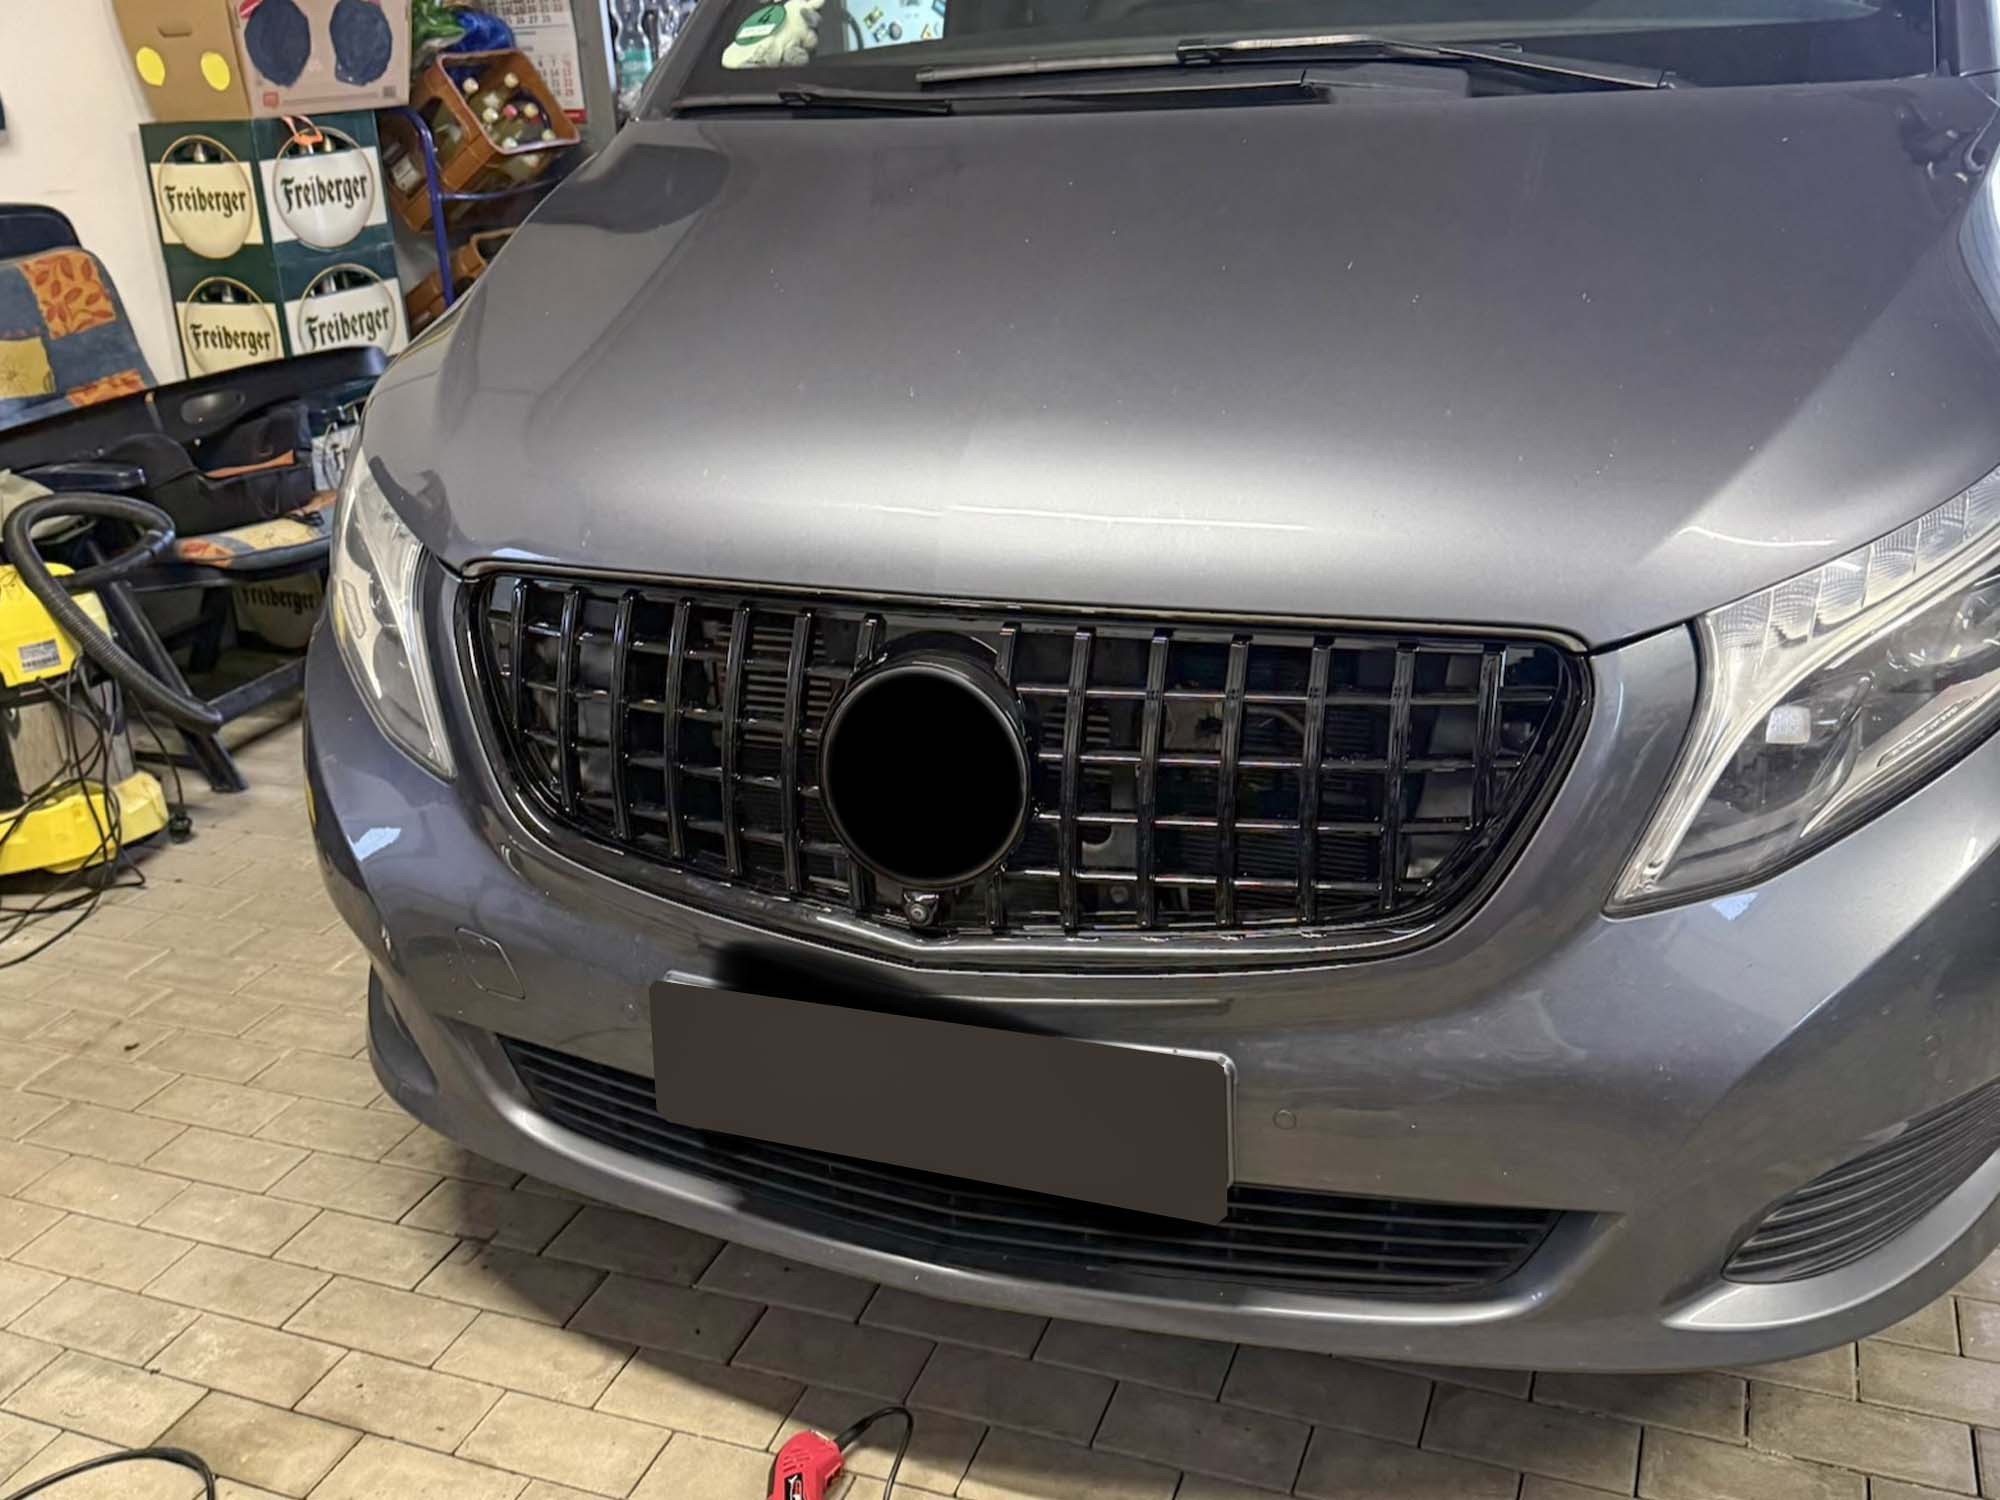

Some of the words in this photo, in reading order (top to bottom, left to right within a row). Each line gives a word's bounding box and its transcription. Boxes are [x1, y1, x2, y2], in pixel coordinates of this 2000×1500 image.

[757, 5, 774, 25] 4
[163, 185, 247, 218] Freiberger
[280, 173, 368, 214] Freiberger
[190, 323, 271, 356] Freiberger
[305, 305, 390, 349] Freiberger
